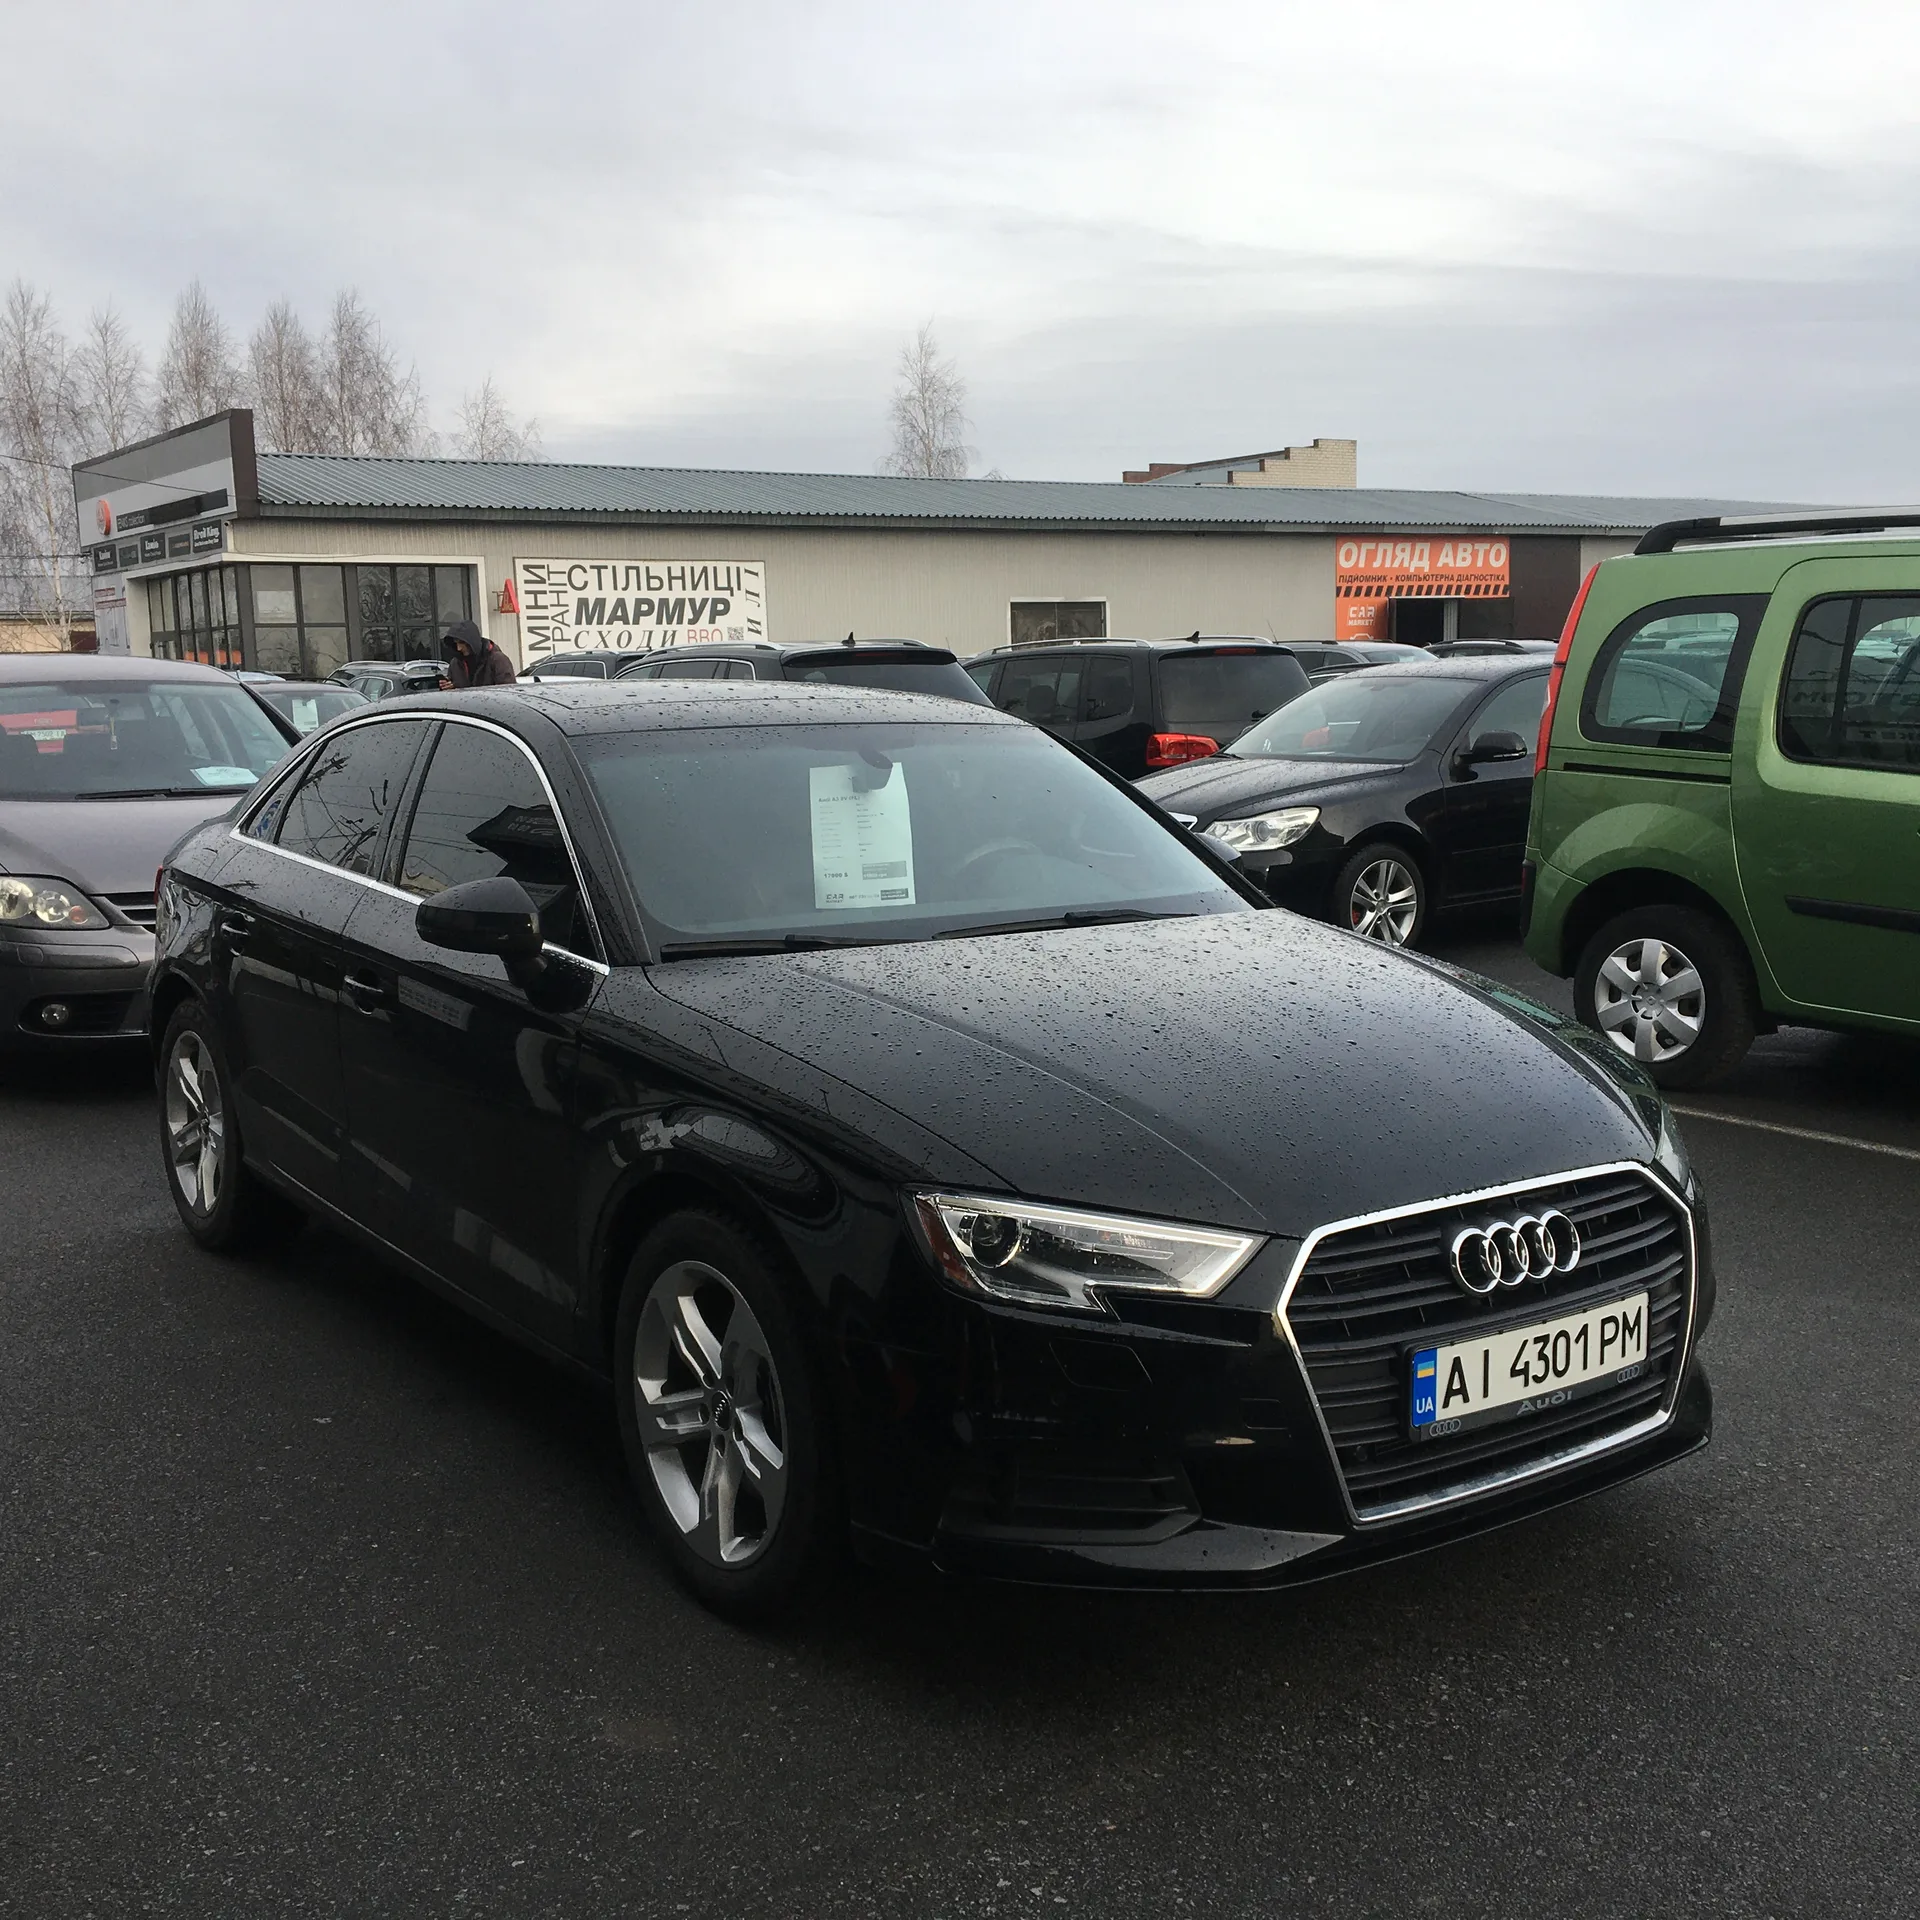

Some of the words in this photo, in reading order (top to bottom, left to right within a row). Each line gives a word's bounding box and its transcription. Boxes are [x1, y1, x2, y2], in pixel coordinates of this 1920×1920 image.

[1338, 542, 1431, 573] ОГЛЯД
[1436, 542, 1507, 568] АВТО
[566, 564, 742, 598] СТІЛЬНИЦІ
[1338, 573, 1388, 584] ПІДЙОМНИК
[573, 597, 731, 626] МАРМУР
[1348, 618, 1375, 627] MARKET
[1349, 606, 1376, 618] CAR
[573, 629, 679, 652] СХОДИ
[1442, 1348, 1490, 1409] AI
[1416, 1396, 1434, 1415] UA
